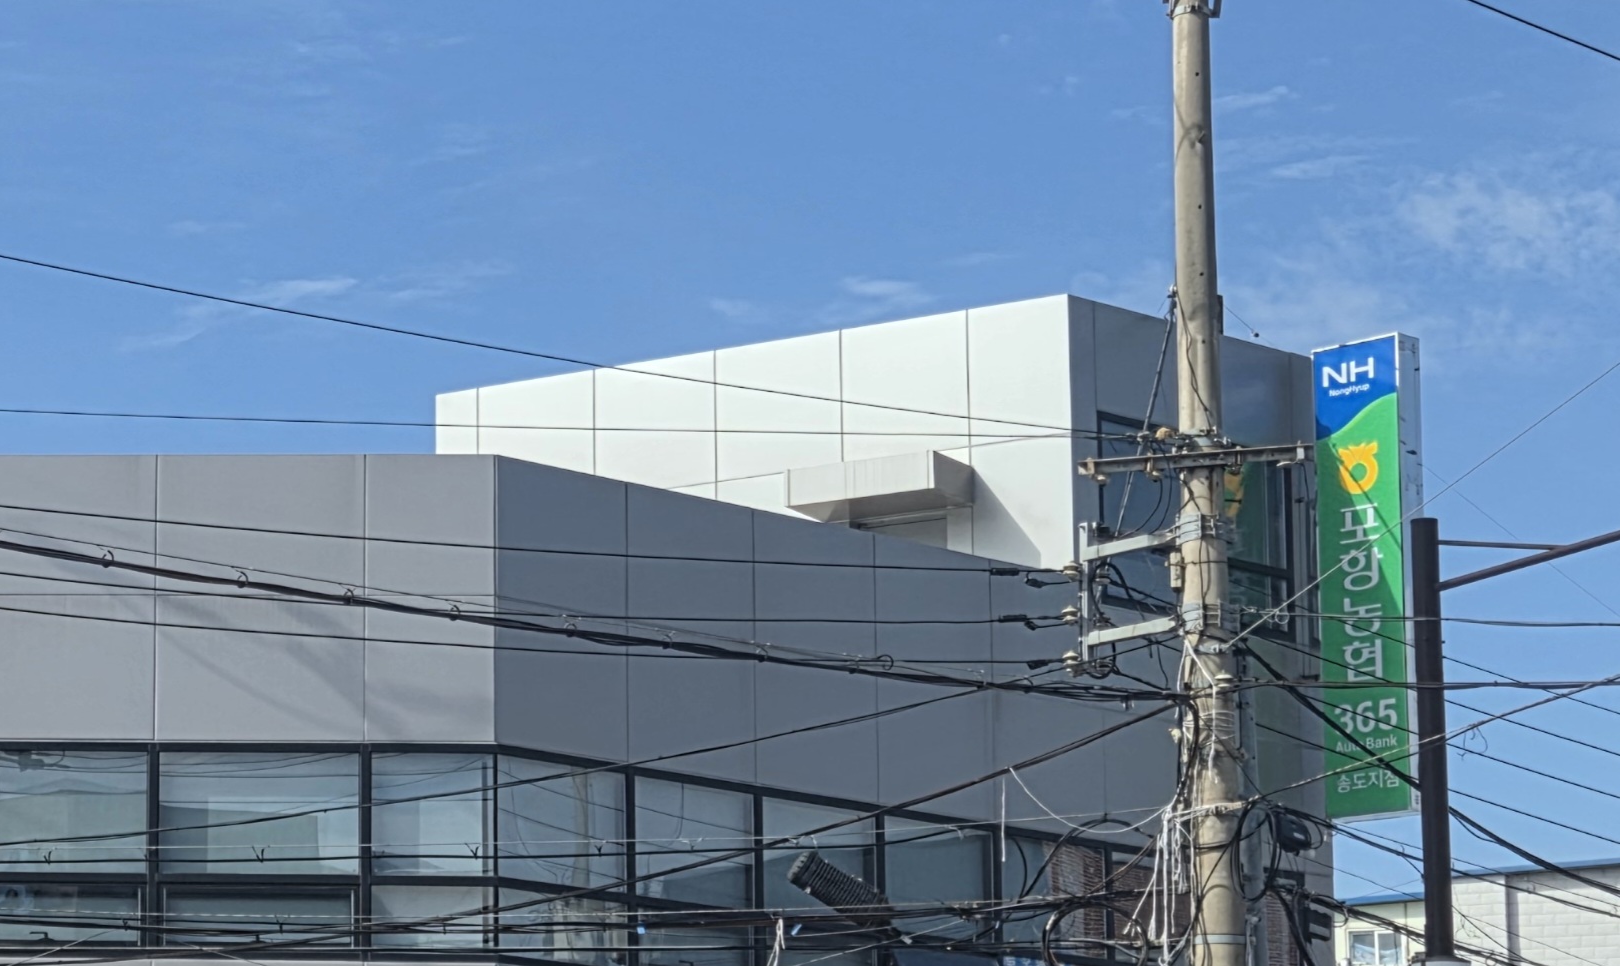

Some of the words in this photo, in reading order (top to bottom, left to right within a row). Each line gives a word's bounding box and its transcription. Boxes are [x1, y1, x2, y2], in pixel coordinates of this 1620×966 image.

[1322, 357, 1375, 388] NH
[1329, 383, 1370, 397] NongHyup
[1339, 503, 1383, 683] 포항농협
[1334, 698, 1398, 734] 365
[1337, 770, 1399, 793] 송도지점
